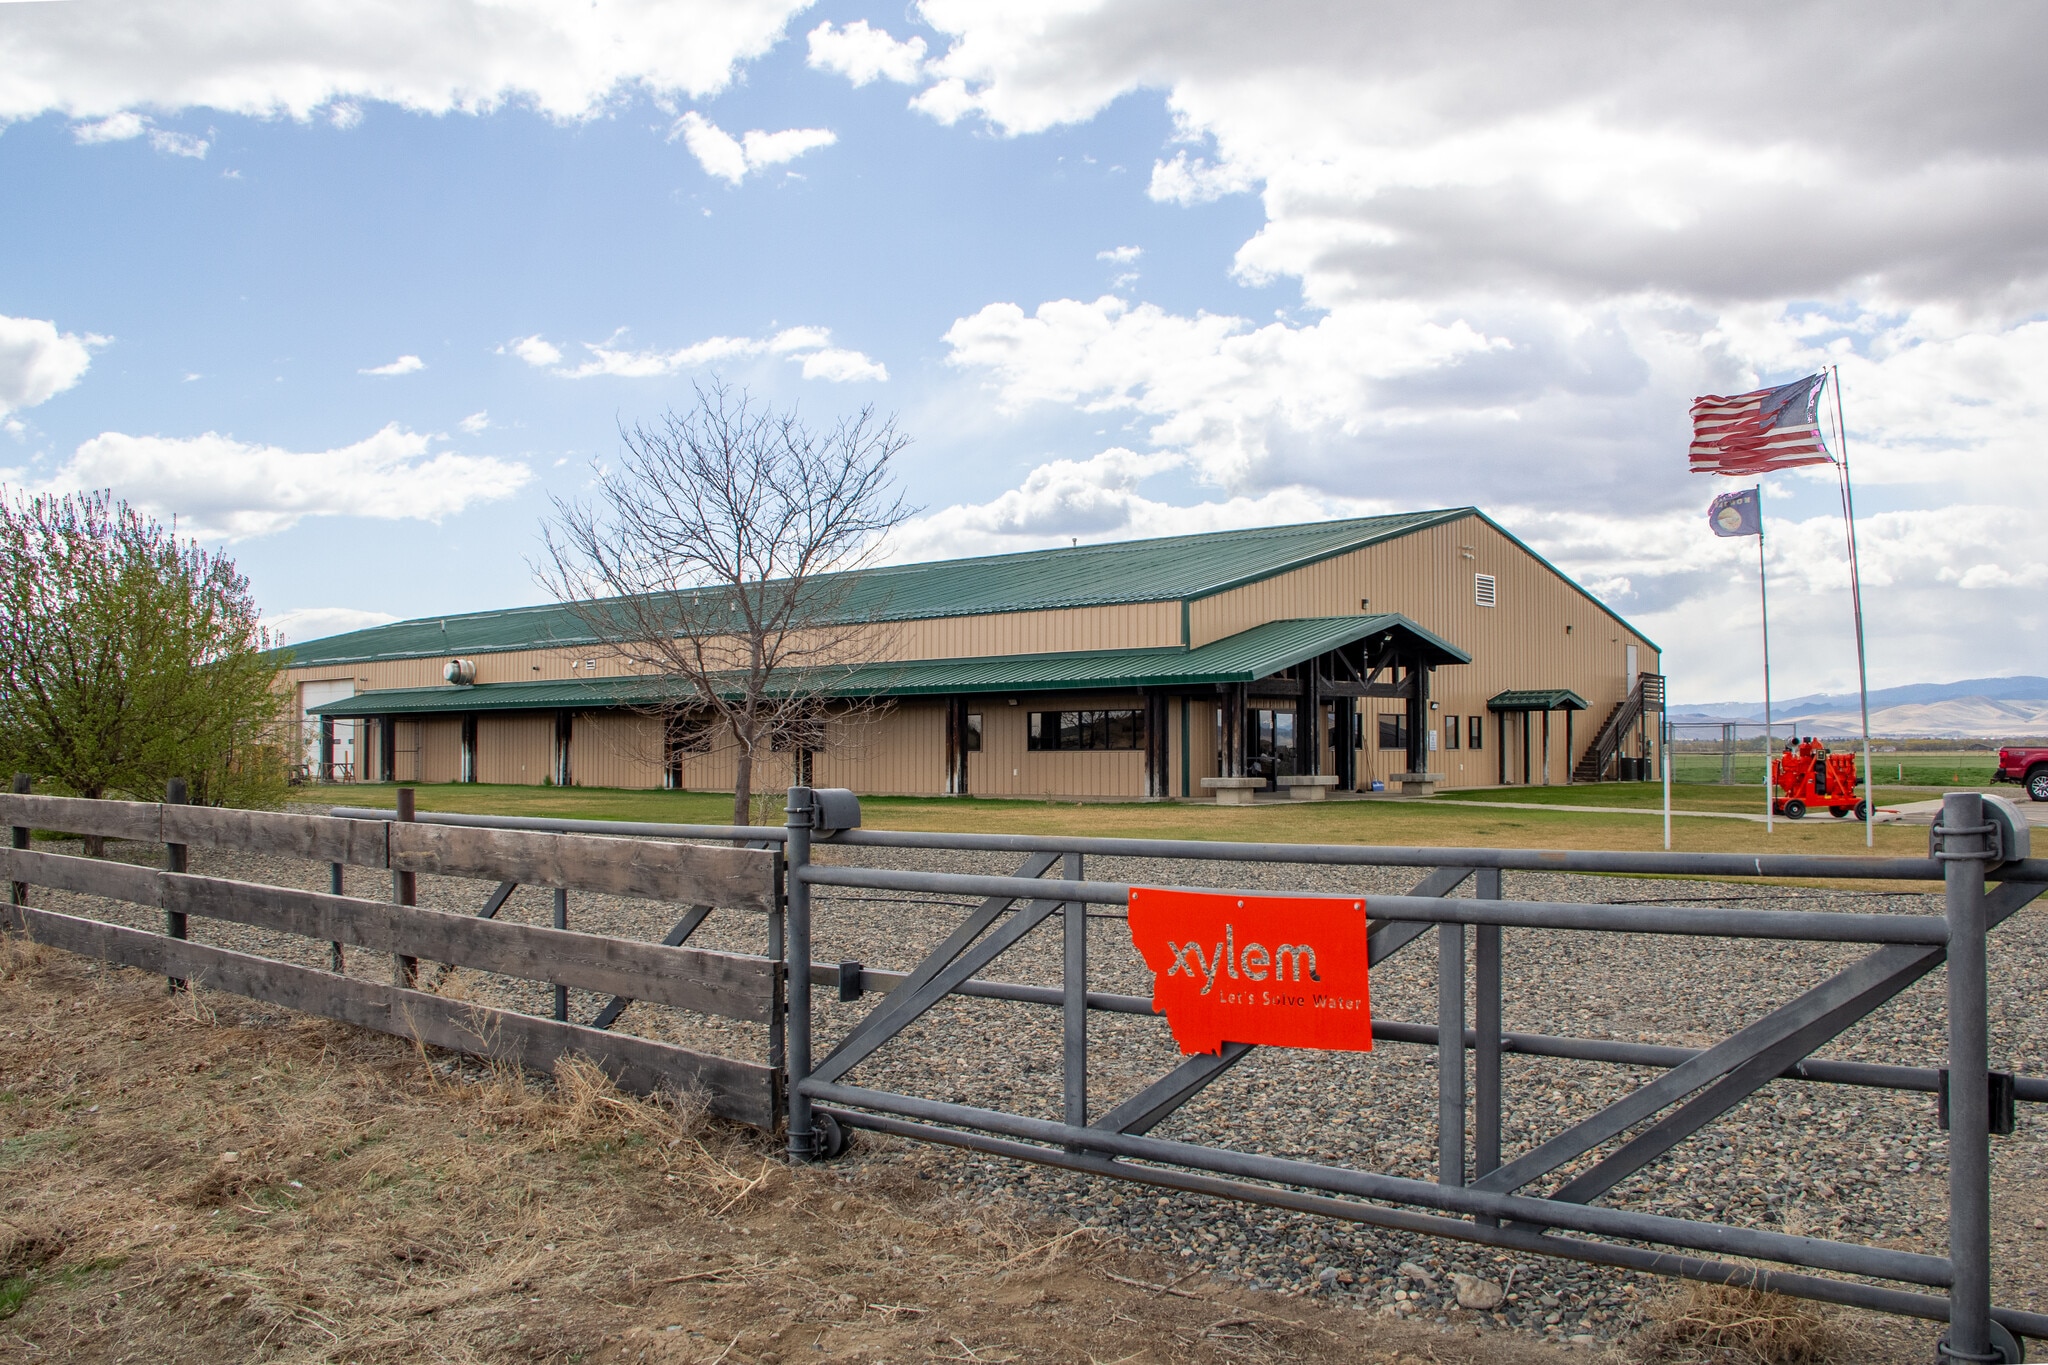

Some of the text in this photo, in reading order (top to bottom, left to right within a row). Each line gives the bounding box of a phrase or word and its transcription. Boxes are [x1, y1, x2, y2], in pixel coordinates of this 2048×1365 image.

[1167, 923, 1321, 995] xylem
[1219, 990, 1361, 1010] Let's Solve Water
